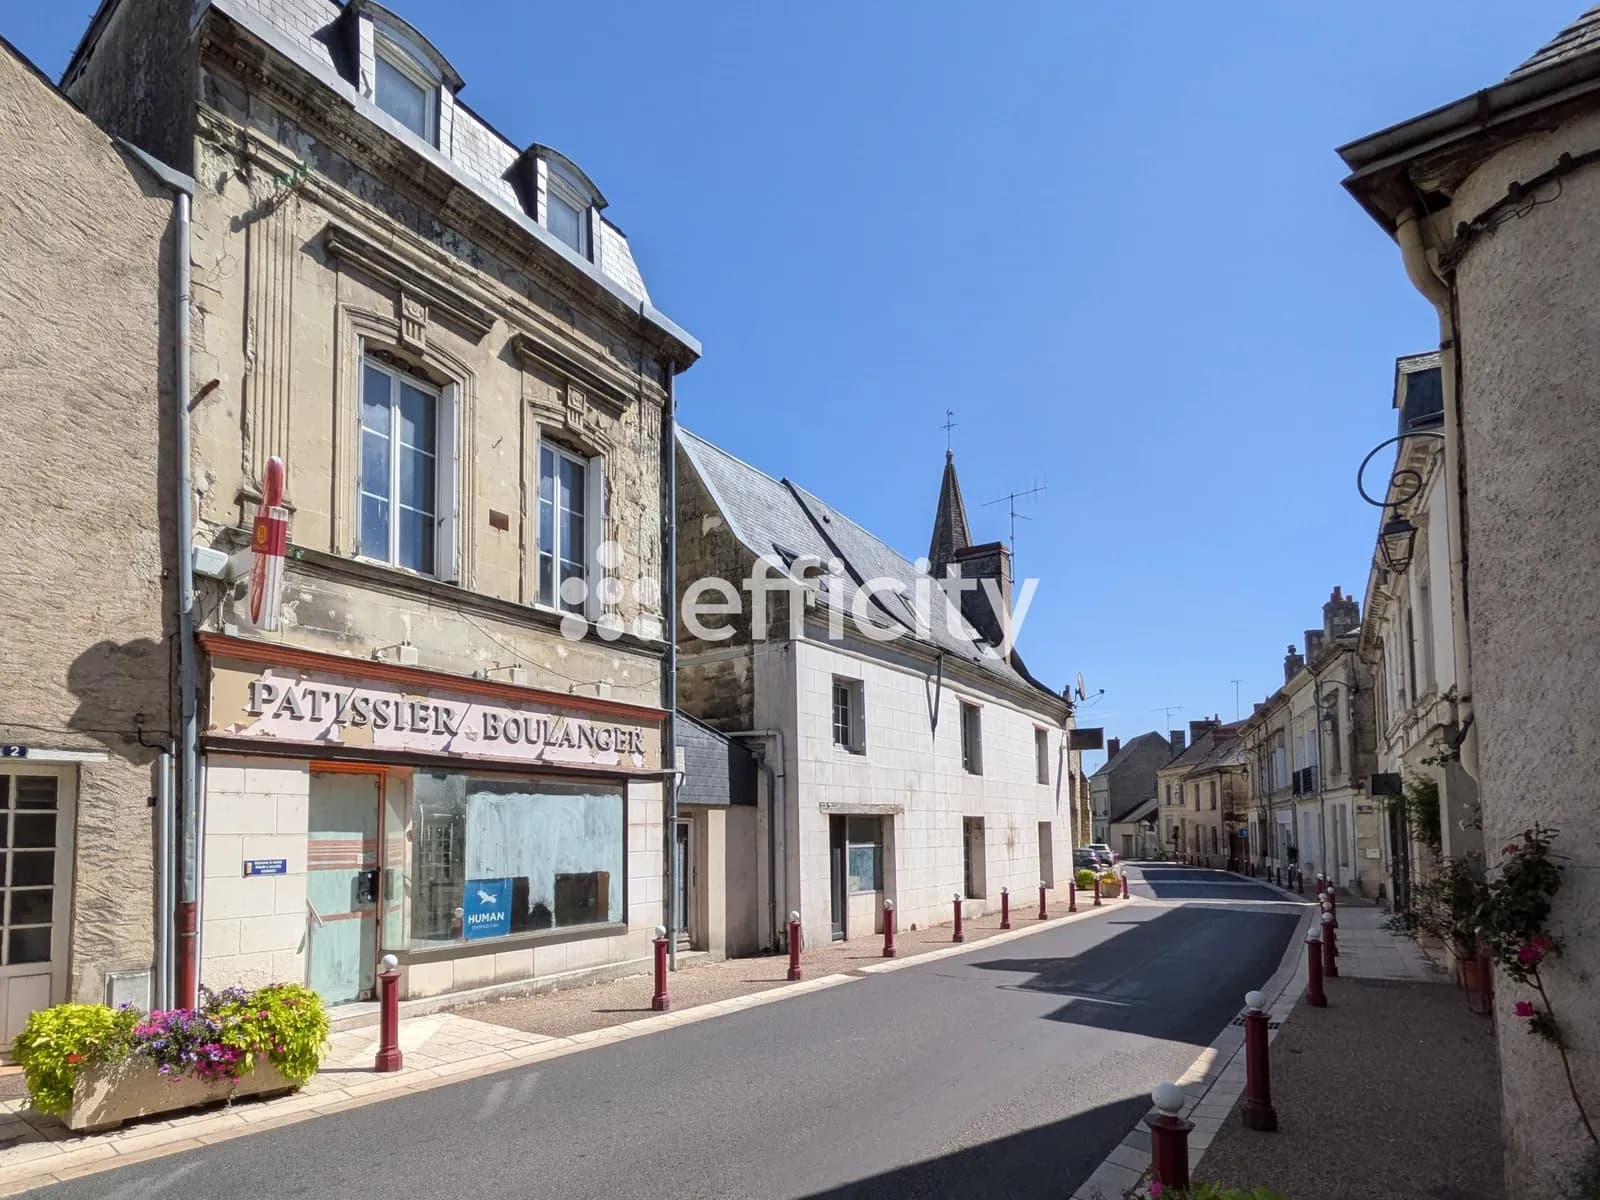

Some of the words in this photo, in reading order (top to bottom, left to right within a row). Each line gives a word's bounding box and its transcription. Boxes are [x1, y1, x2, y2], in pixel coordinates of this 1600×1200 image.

[247, 680, 459, 737] PATISSIER
[482, 712, 646, 755] BOULANGER
[10, 746, 20, 757] 2
[467, 911, 505, 925] HUMAN
